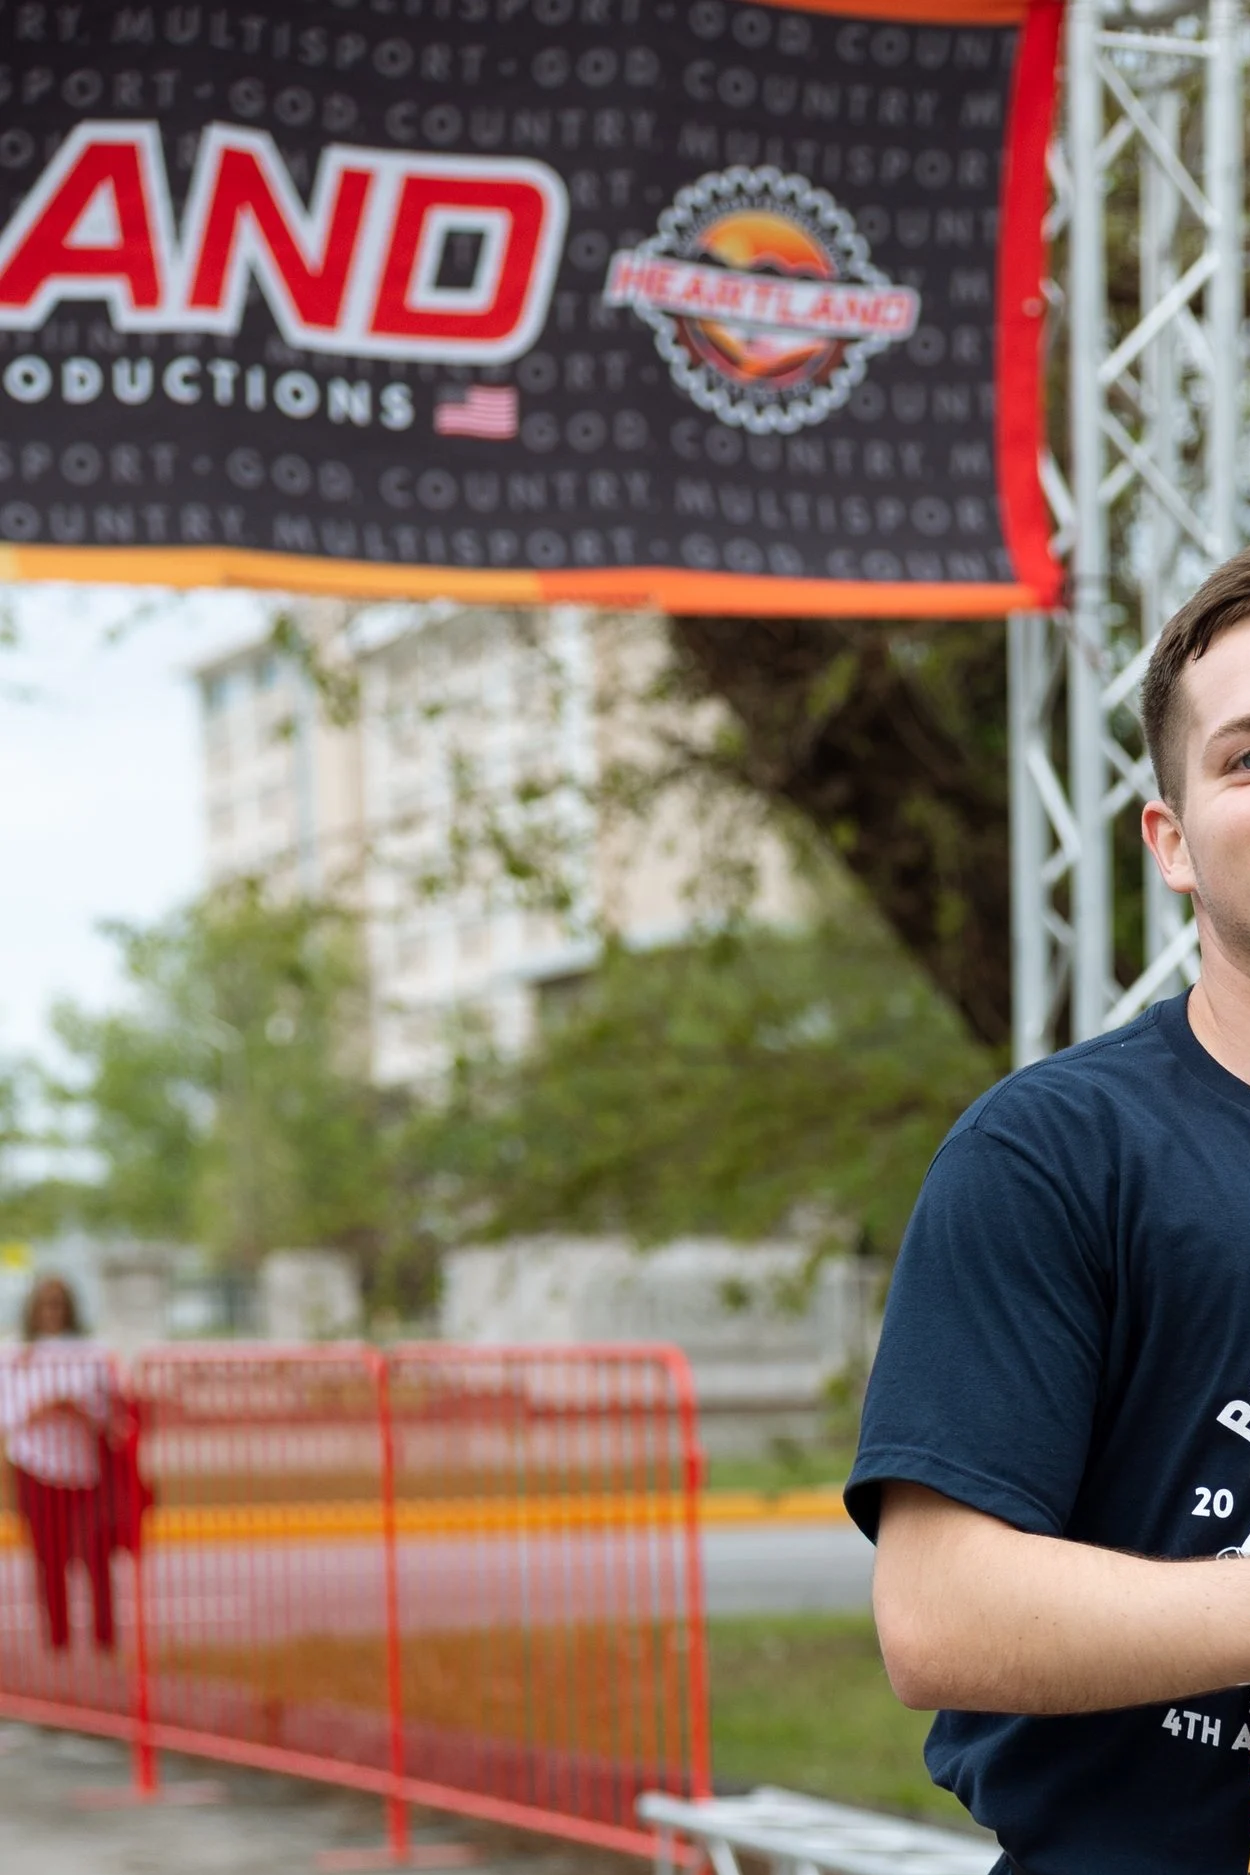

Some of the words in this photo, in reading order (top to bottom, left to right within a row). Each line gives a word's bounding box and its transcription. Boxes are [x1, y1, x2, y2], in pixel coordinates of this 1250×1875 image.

[110, 5, 487, 85] MULTISPORT
[0, 119, 568, 365] AND
[613, 254, 915, 334] HEARTLAND
[2, 354, 415, 431] ODUCTIONS
[1191, 1486, 1234, 1518] 20
[1161, 1707, 1222, 1747] 4TH
